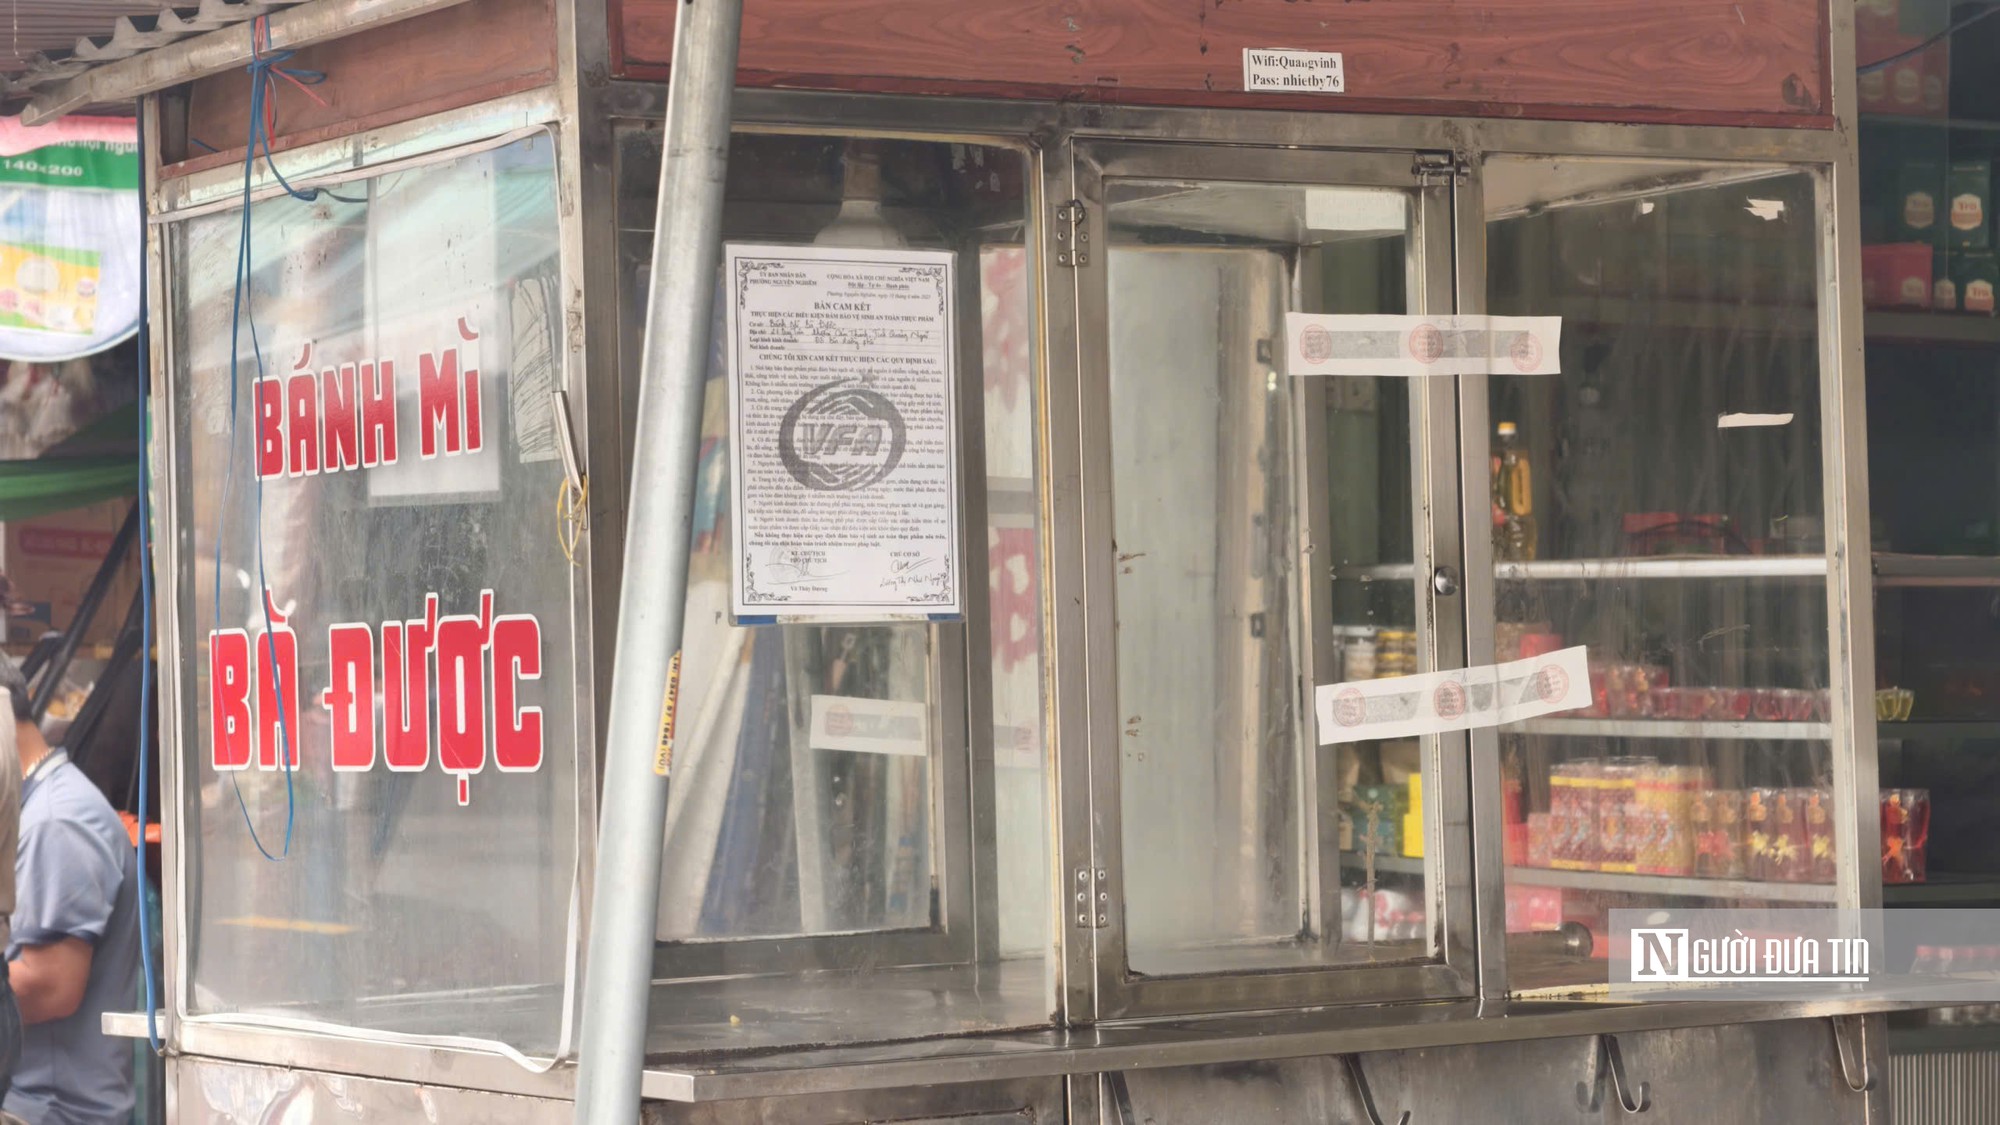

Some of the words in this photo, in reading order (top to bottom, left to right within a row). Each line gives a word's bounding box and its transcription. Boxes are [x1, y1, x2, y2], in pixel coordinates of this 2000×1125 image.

[1251, 54, 1337, 71] Wifi:Quangvinh
[1253, 73, 1280, 86] Pass:
[1283, 74, 1340, 90] nhietby76
[4, 160, 84, 176] 140x200
[814, 300, 831, 310] BẢN
[833, 302, 852, 311] CAM
[854, 301, 871, 311] KẾT
[252, 341, 398, 481] BÁNH
[418, 316, 484, 460] MÌ
[802, 423, 883, 456] VFA
[208, 585, 301, 772] BÀ
[322, 589, 544, 806] ĐƯỢC
